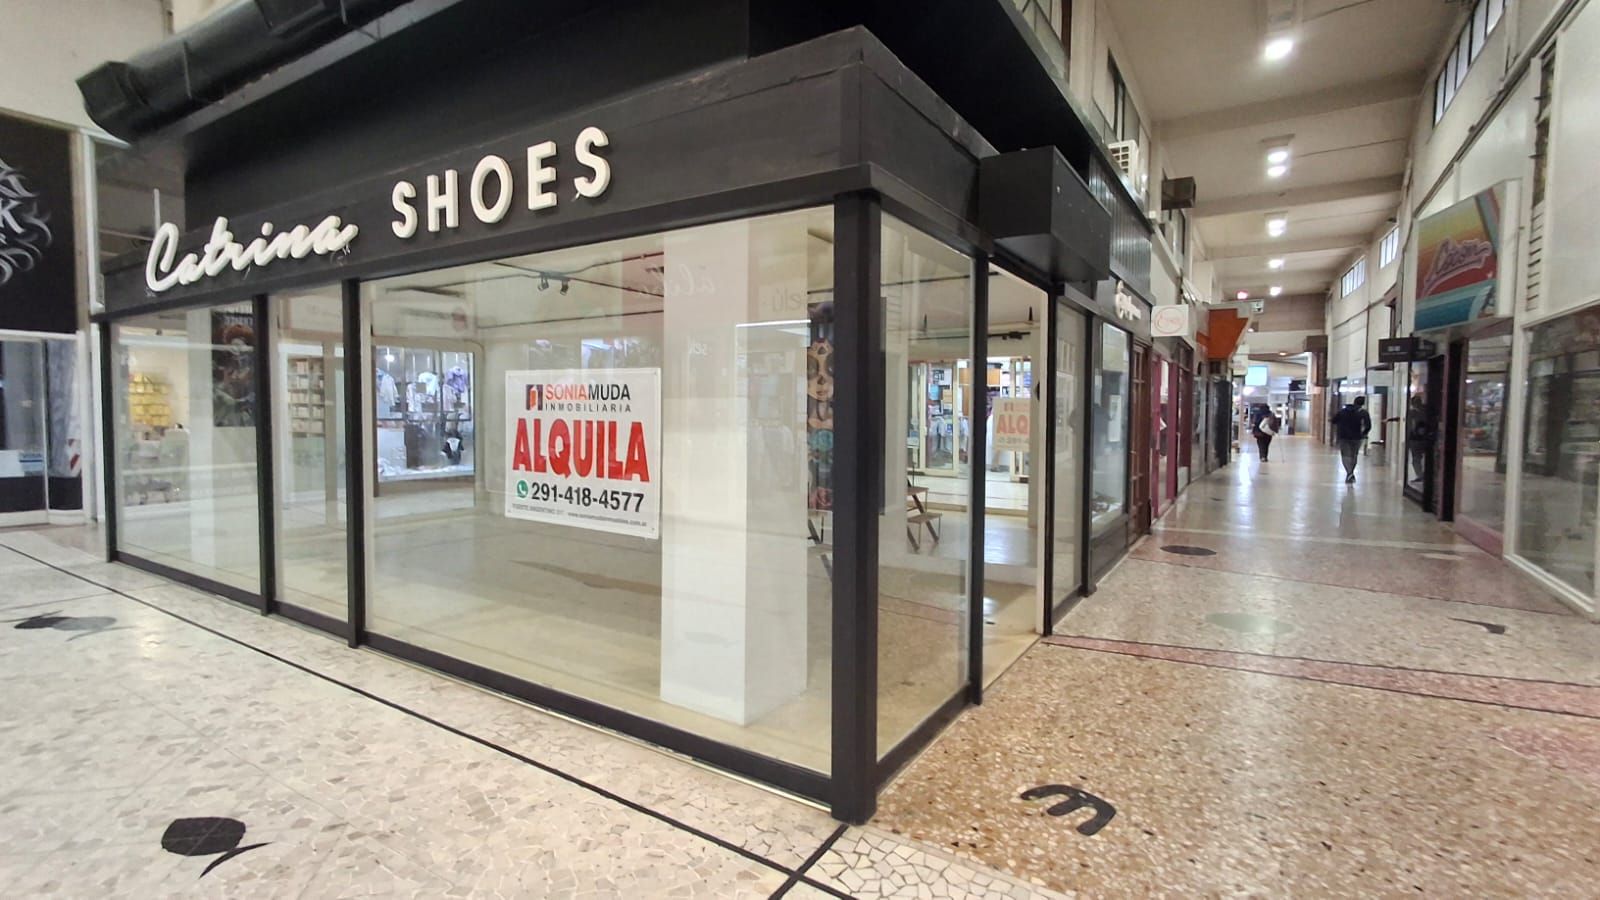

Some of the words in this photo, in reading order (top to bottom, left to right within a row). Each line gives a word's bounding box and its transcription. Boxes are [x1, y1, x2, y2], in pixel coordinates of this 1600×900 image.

[145, 216, 359, 292] Catrina
[391, 126, 611, 239] SHOES
[545, 402, 632, 413] INMOBILIARIA
[512, 417, 650, 483] ALQUILA
[531, 481, 645, 513] 291-418-4577
